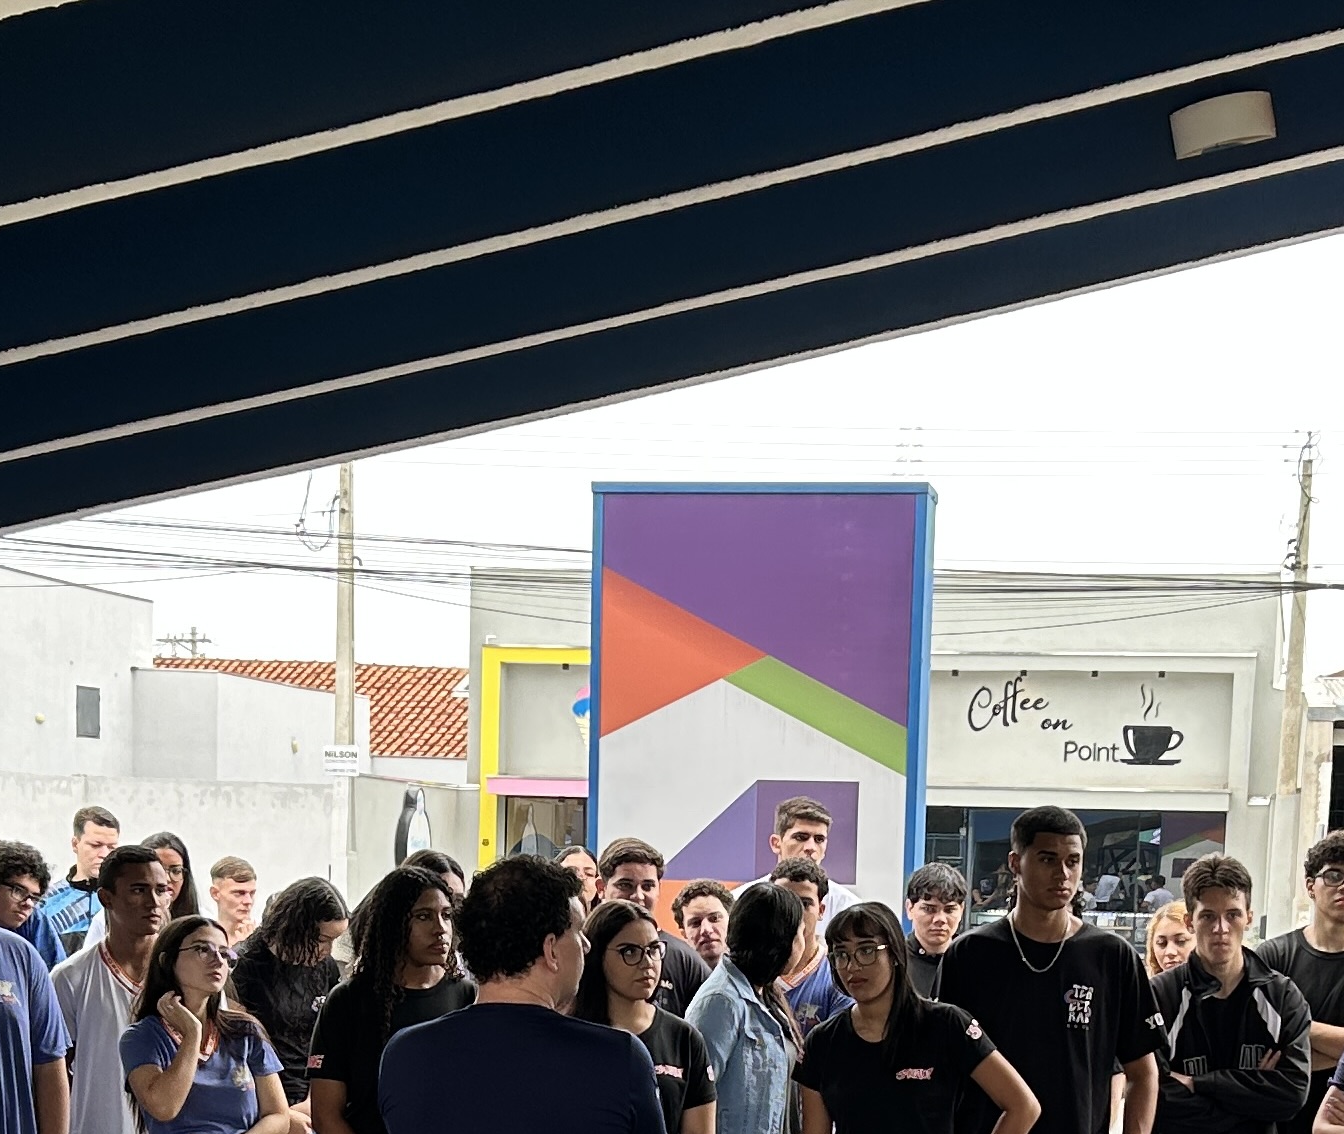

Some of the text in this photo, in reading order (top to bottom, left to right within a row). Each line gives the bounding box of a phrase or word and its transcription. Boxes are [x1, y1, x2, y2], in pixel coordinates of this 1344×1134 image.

[968, 676, 1049, 732] Coffee
[1040, 718, 1073, 731] on
[1063, 740, 1120, 763] Point
